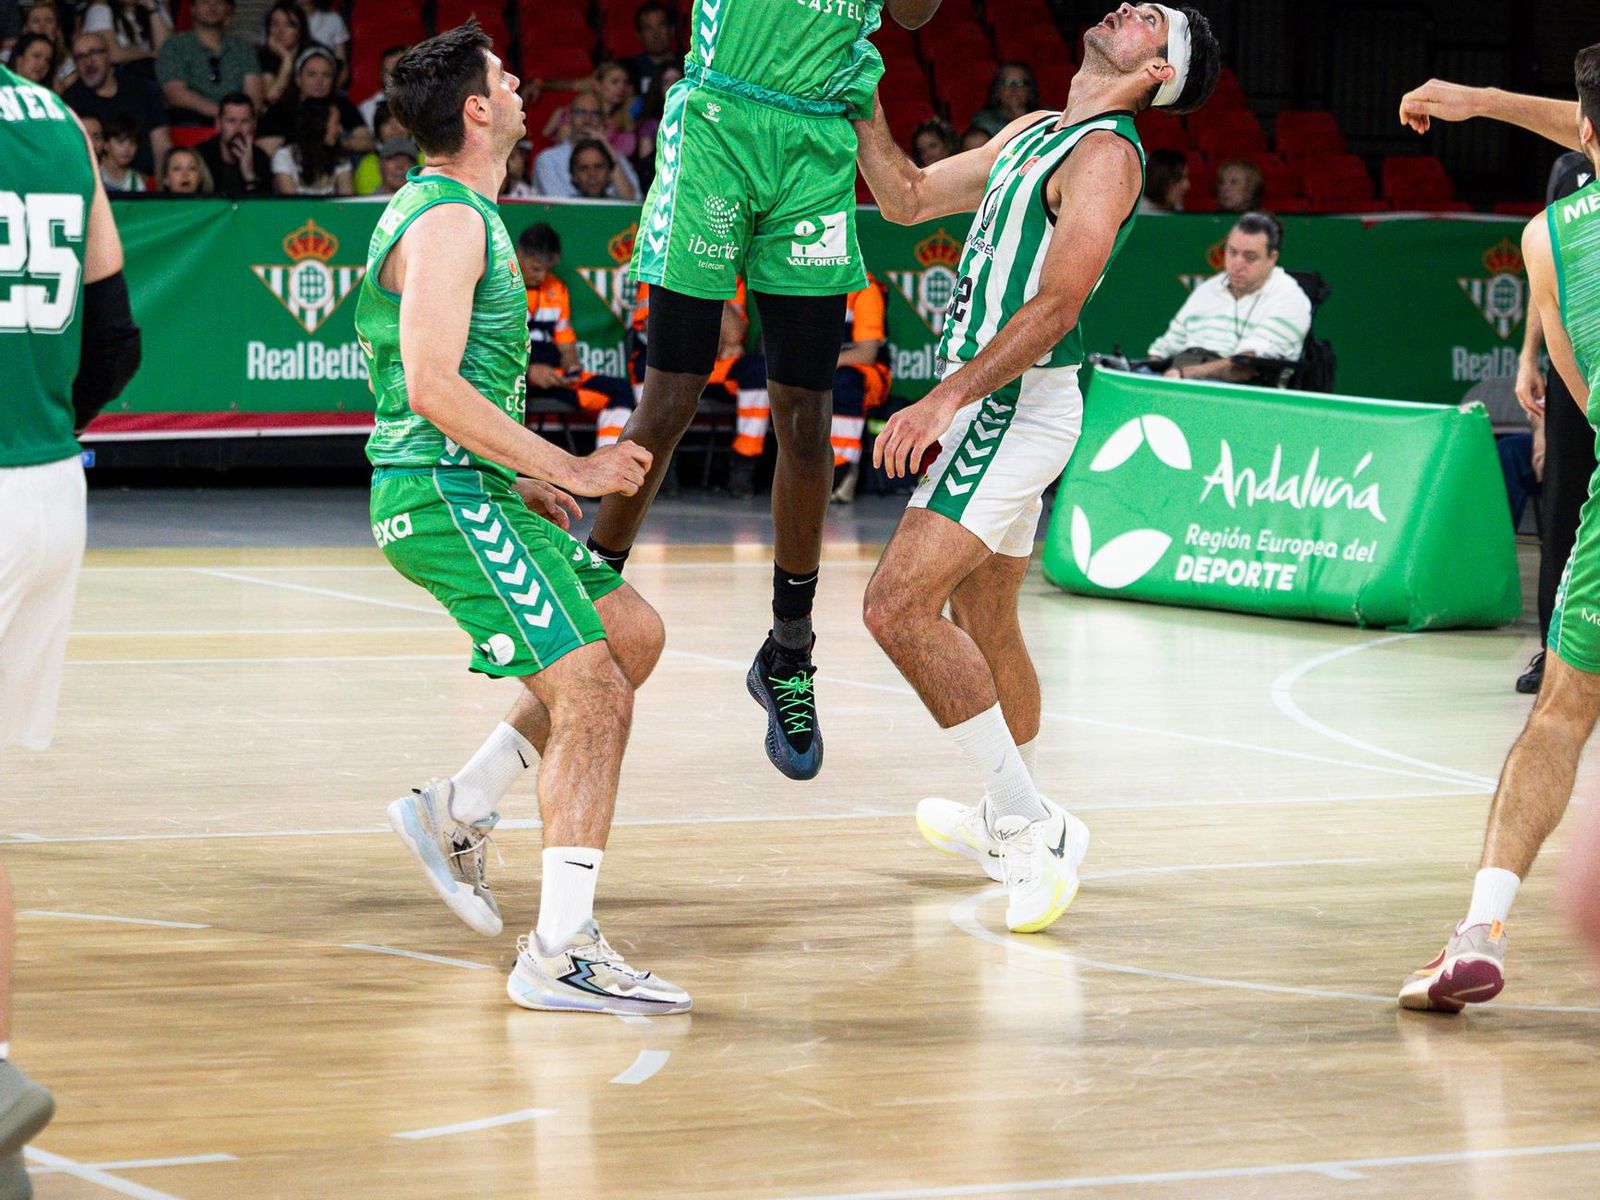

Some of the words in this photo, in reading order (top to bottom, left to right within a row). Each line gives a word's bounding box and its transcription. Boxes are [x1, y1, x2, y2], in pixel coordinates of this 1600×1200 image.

[786, 256, 852, 266] VALFORTEC
[246, 341, 305, 380] Real
[1200, 438, 1388, 524] Andalucía
[1185, 523, 1252, 555] Región
[1256, 529, 1338, 562] Europea
[1343, 538, 1378, 563] del
[1174, 554, 1298, 592] DEPORTE
